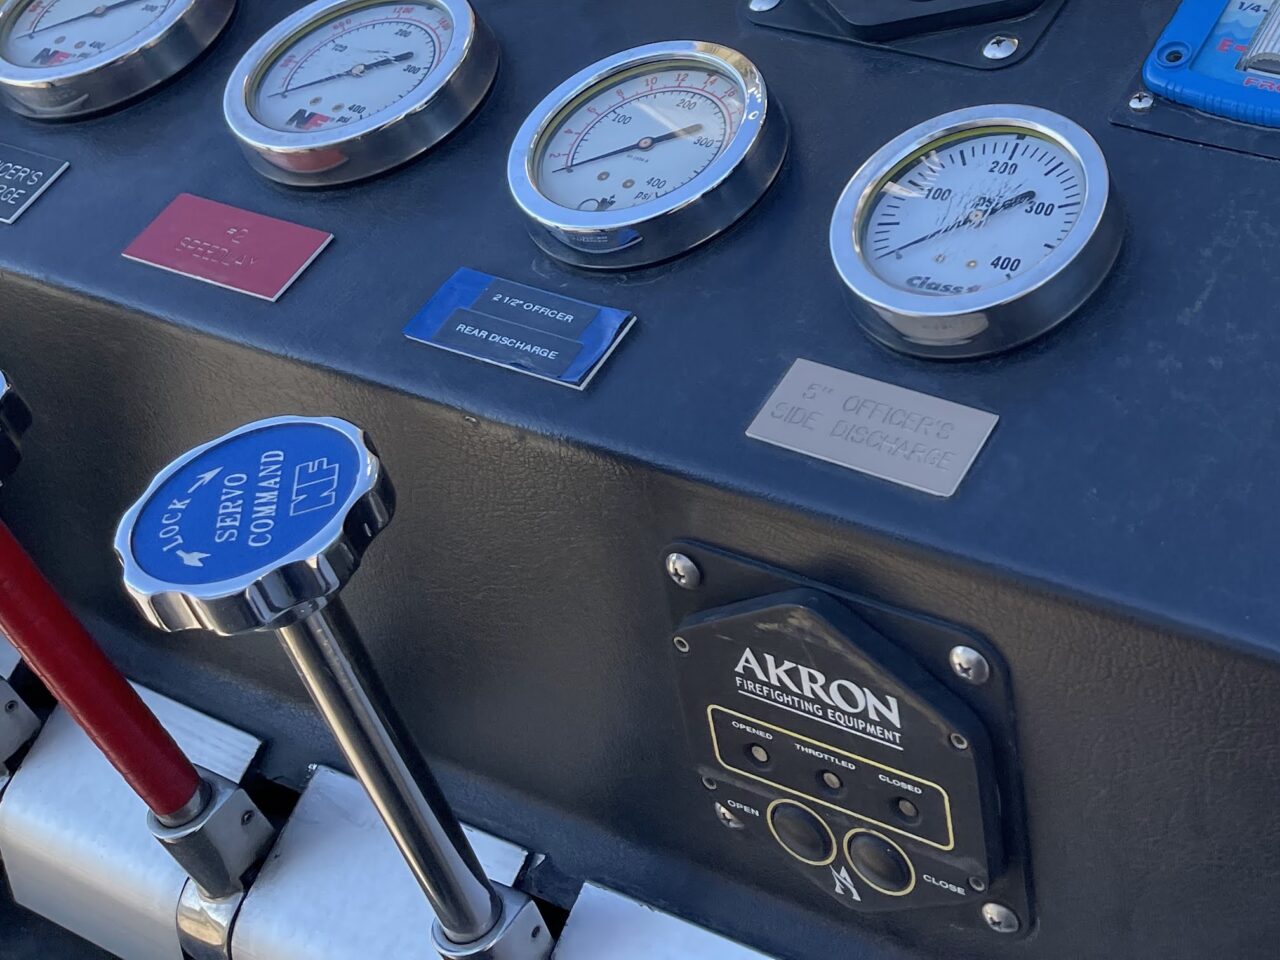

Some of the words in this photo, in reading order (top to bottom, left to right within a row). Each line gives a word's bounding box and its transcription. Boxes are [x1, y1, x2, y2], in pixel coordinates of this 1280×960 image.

[1236, 0, 1262, 14] 1/4
[1216, 38, 1234, 53] E
[402, 64, 422, 75] 300
[676, 73, 689, 82] 12
[644, 76, 659, 86] 10
[347, 103, 367, 115] 400
[675, 98, 697, 111] 200
[612, 114, 633, 125] 100
[693, 136, 714, 148] 300
[988, 160, 1019, 176] 200
[645, 177, 667, 189] 400
[634, 191, 652, 201] psi
[924, 186, 952, 201] 100
[1024, 201, 1055, 217] 300
[990, 255, 1021, 272] 400
[492, 293, 503, 302] 2
[523, 301, 575, 324] OFFICER
[455, 322, 489, 340] REAR
[489, 333, 560, 361] DISCHARGE
[801, 382, 834, 401] 5"
[841, 395, 955, 440] OFFICER'S
[770, 402, 823, 431] SIDE
[829, 418, 957, 471] DISCHARGE
[215, 472, 248, 543] SERVO
[248, 450, 286, 548] COMMAND
[160, 497, 191, 553] LOCK
[734, 646, 902, 729] AKRON
[735, 676, 825, 718] FIREFIGHTING
[826, 708, 903, 745] EQUIPMENT
[731, 720, 773, 740] OPENED
[794, 742, 856, 771] THROTTLED
[878, 773, 923, 795] CLOSED
[727, 799, 760, 818] OPEN
[922, 874, 967, 896] CLOSE
